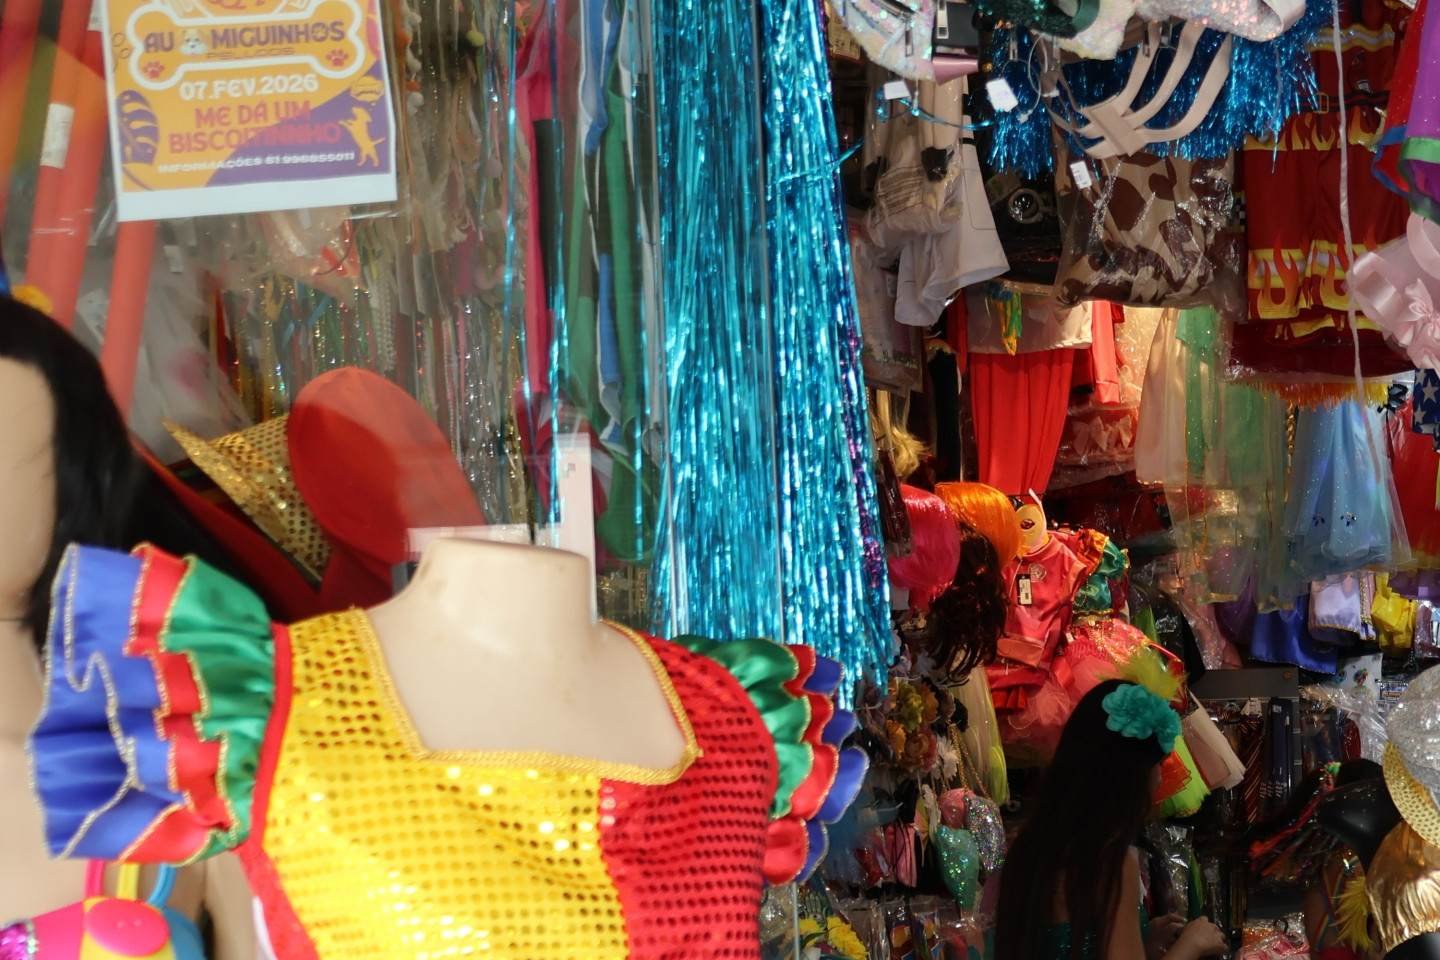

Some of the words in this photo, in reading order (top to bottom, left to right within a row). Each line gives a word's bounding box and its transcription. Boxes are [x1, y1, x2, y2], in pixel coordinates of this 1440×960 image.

[144, 32, 175, 52] AU
[211, 21, 345, 49] MIGUINHOS
[179, 75, 320, 100] 07.FEV.2026
[194, 106, 231, 129] ME
[237, 102, 269, 125] DÁ
[275, 101, 312, 120] UM
